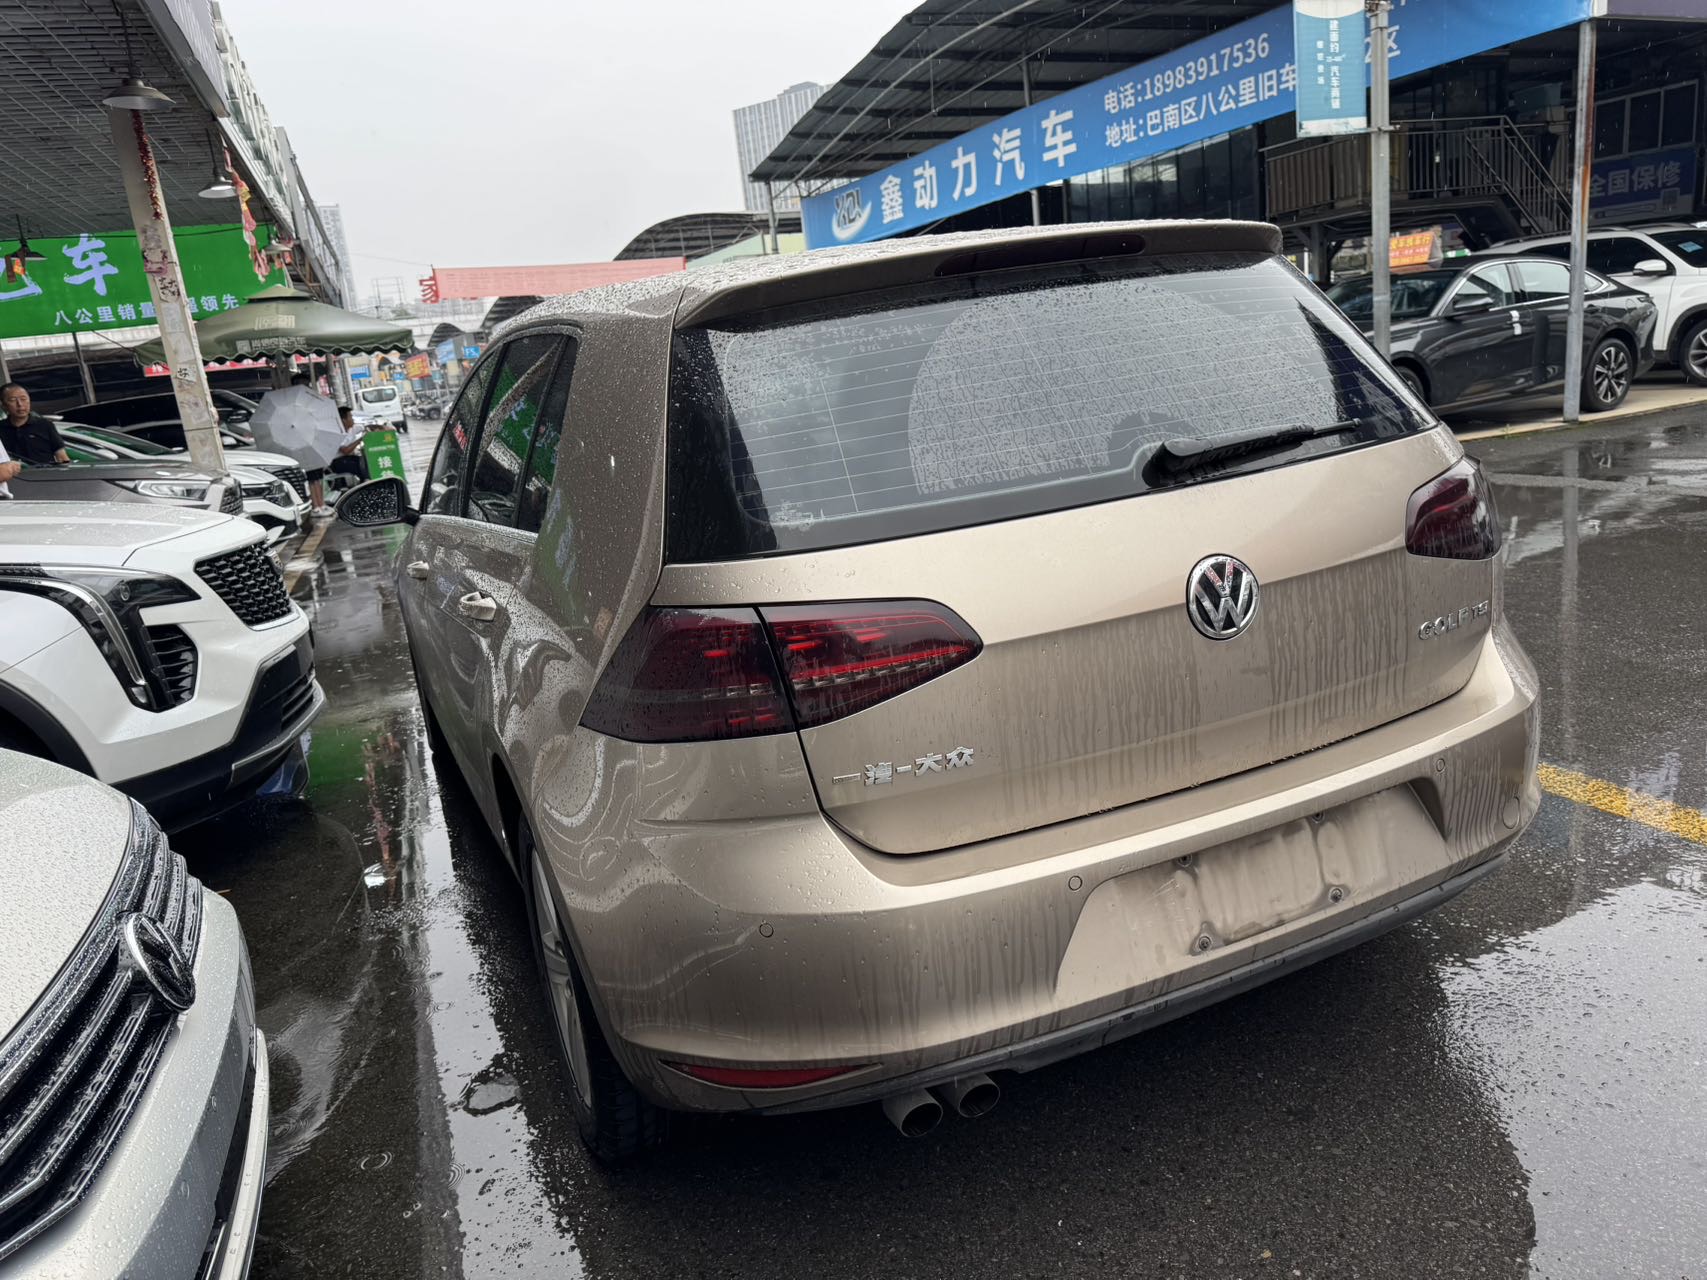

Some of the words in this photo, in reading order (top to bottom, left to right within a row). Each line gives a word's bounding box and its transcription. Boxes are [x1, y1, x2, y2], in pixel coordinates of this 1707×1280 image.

[1104, 33, 1270, 115] 电话:18983917536
[880, 110, 1078, 225] 鑫动力汽车
[1418, 606, 1470, 641] GOLF
